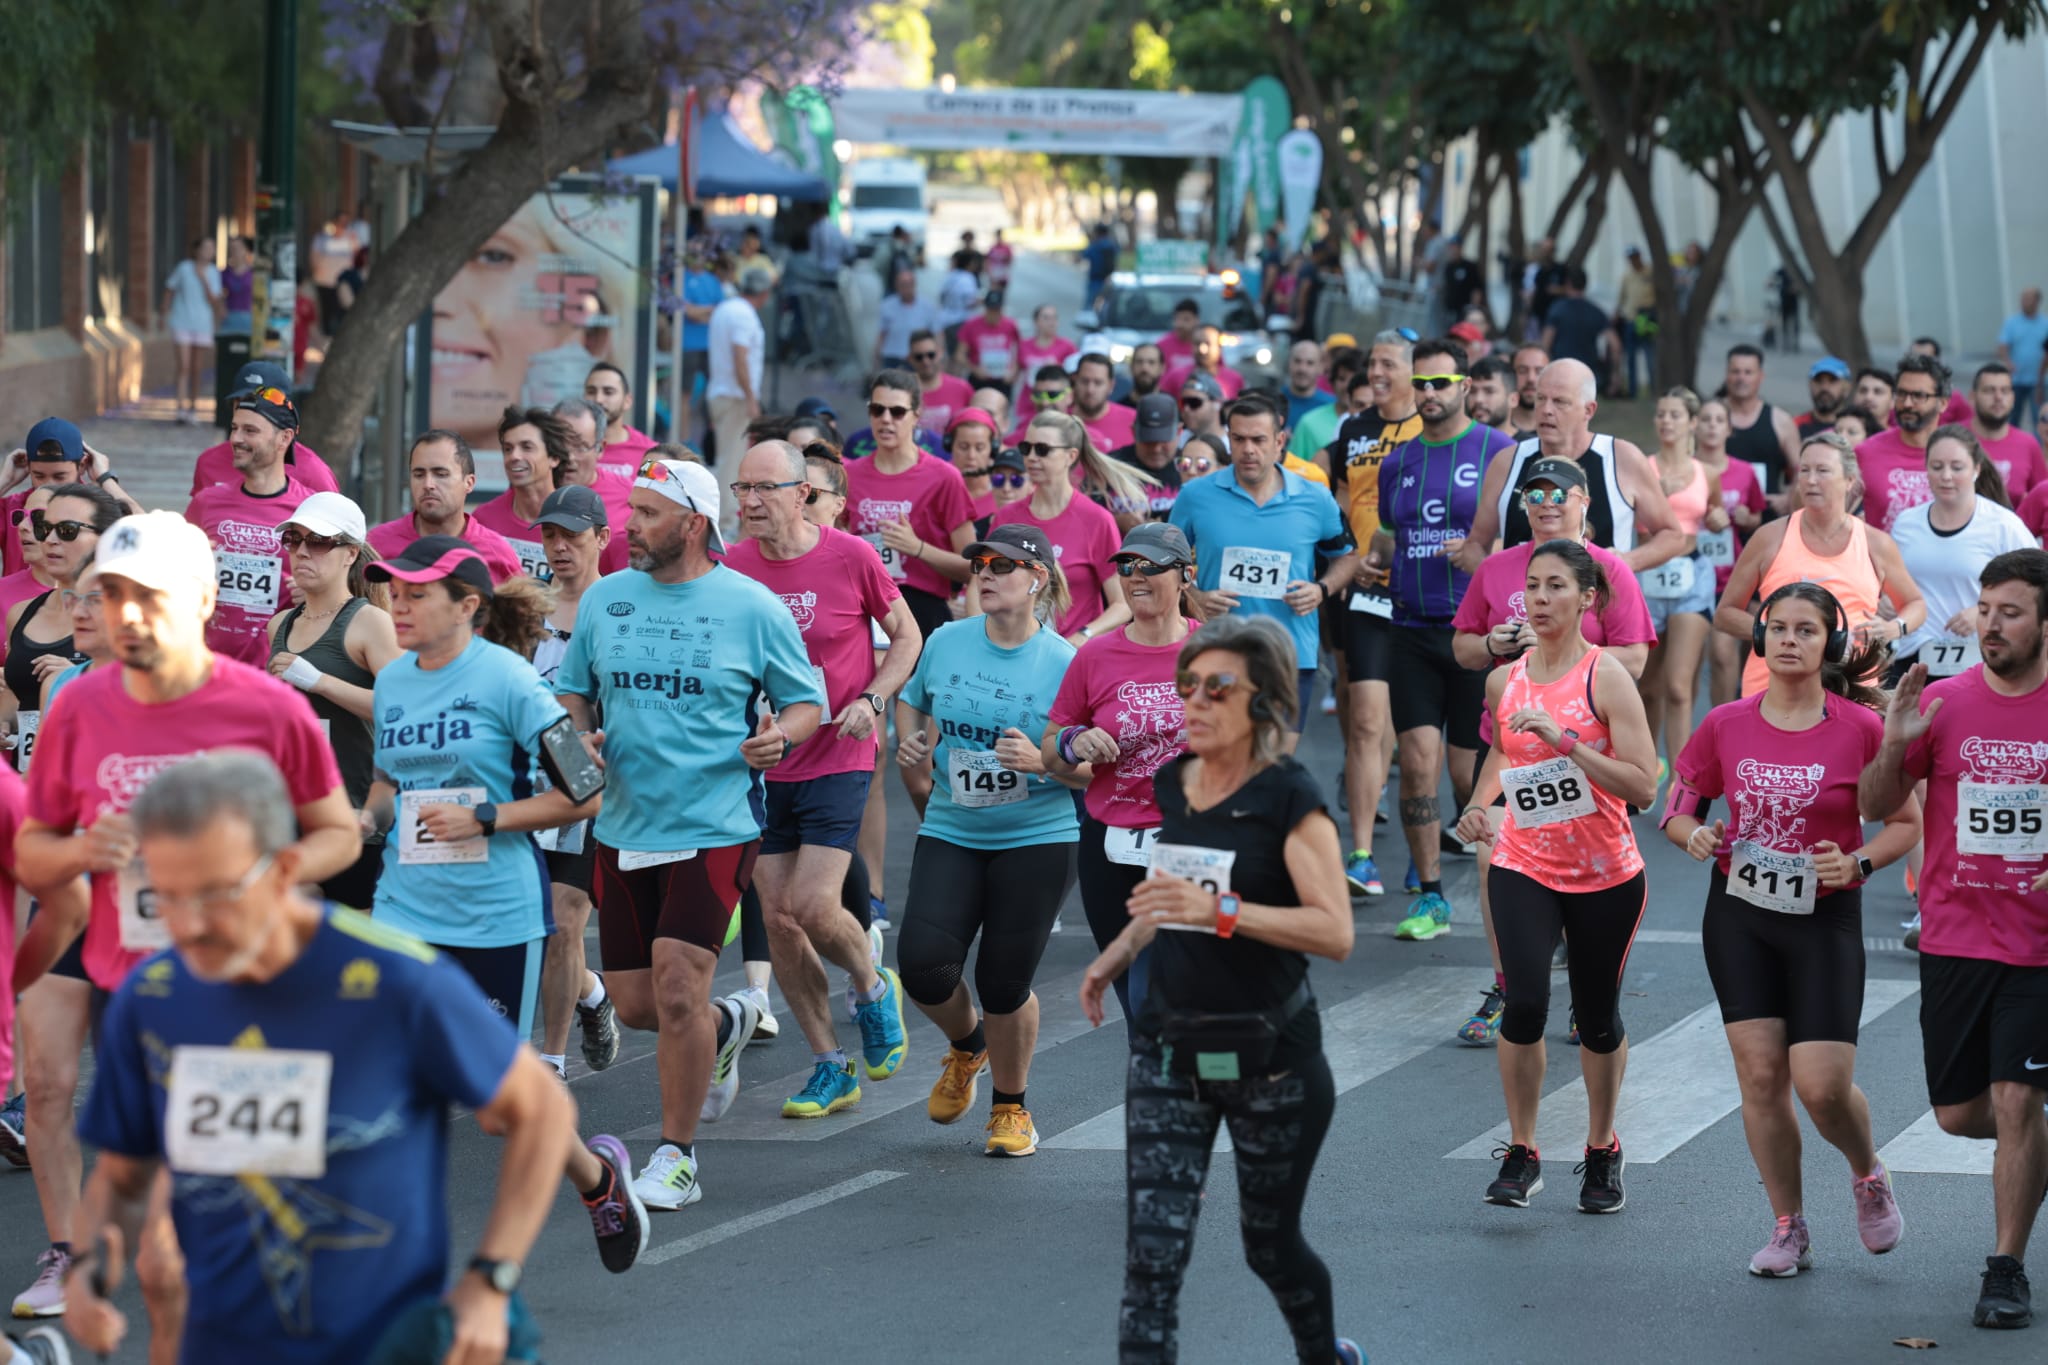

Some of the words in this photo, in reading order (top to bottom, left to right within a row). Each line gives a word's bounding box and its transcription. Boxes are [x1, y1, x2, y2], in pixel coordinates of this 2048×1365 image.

[1408, 527, 1465, 544] talleres
[219, 570, 272, 594] 264
[1229, 563, 1279, 585] 431
[1656, 572, 1681, 587] 12
[607, 602, 635, 616] TROPS
[1933, 646, 1965, 663] 77
[611, 668, 704, 699] nerja
[1121, 683, 1177, 699] Carrer
[380, 711, 473, 751] nerja
[940, 717, 1013, 750] nerj
[1965, 740, 2033, 756] Carrera
[957, 769, 1017, 792] 149
[1741, 761, 1808, 779] Carrera
[1515, 778, 1581, 811] 698
[1969, 807, 2042, 834] 595
[1738, 862, 1804, 898] 411
[188, 1094, 304, 1139] 244
